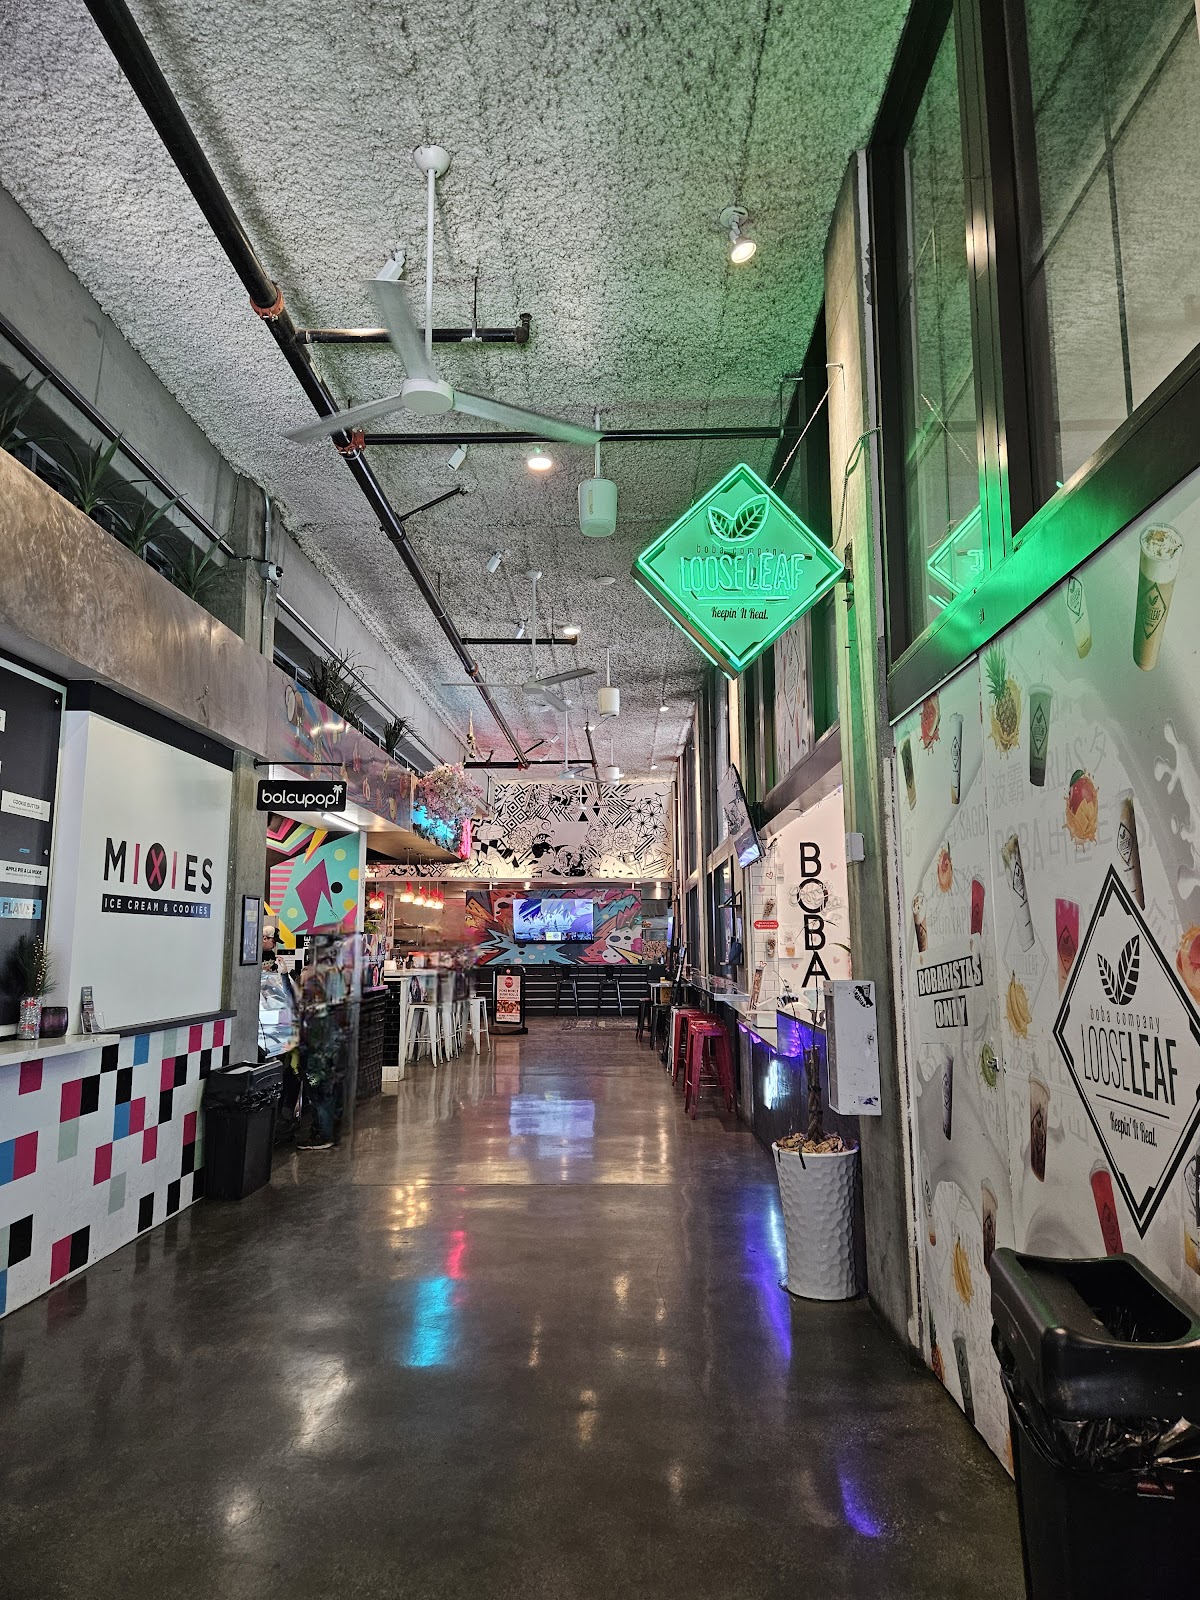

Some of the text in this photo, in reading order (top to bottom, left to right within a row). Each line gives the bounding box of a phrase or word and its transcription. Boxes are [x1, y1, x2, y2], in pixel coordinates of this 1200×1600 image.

[696, 544, 724, 554] boba
[680, 553, 806, 592] LOOSELEAF
[103, 837, 213, 895] MIXIES
[104, 897, 208, 915] ICE CREAM & COOKIES
[797, 842, 831, 988] BOBA
[917, 956, 982, 995] BOBARISTAS
[935, 997, 967, 1028] ONLY
[1090, 1004, 1160, 1034] boba company
[1081, 1024, 1178, 1106] LOOSELEAF
